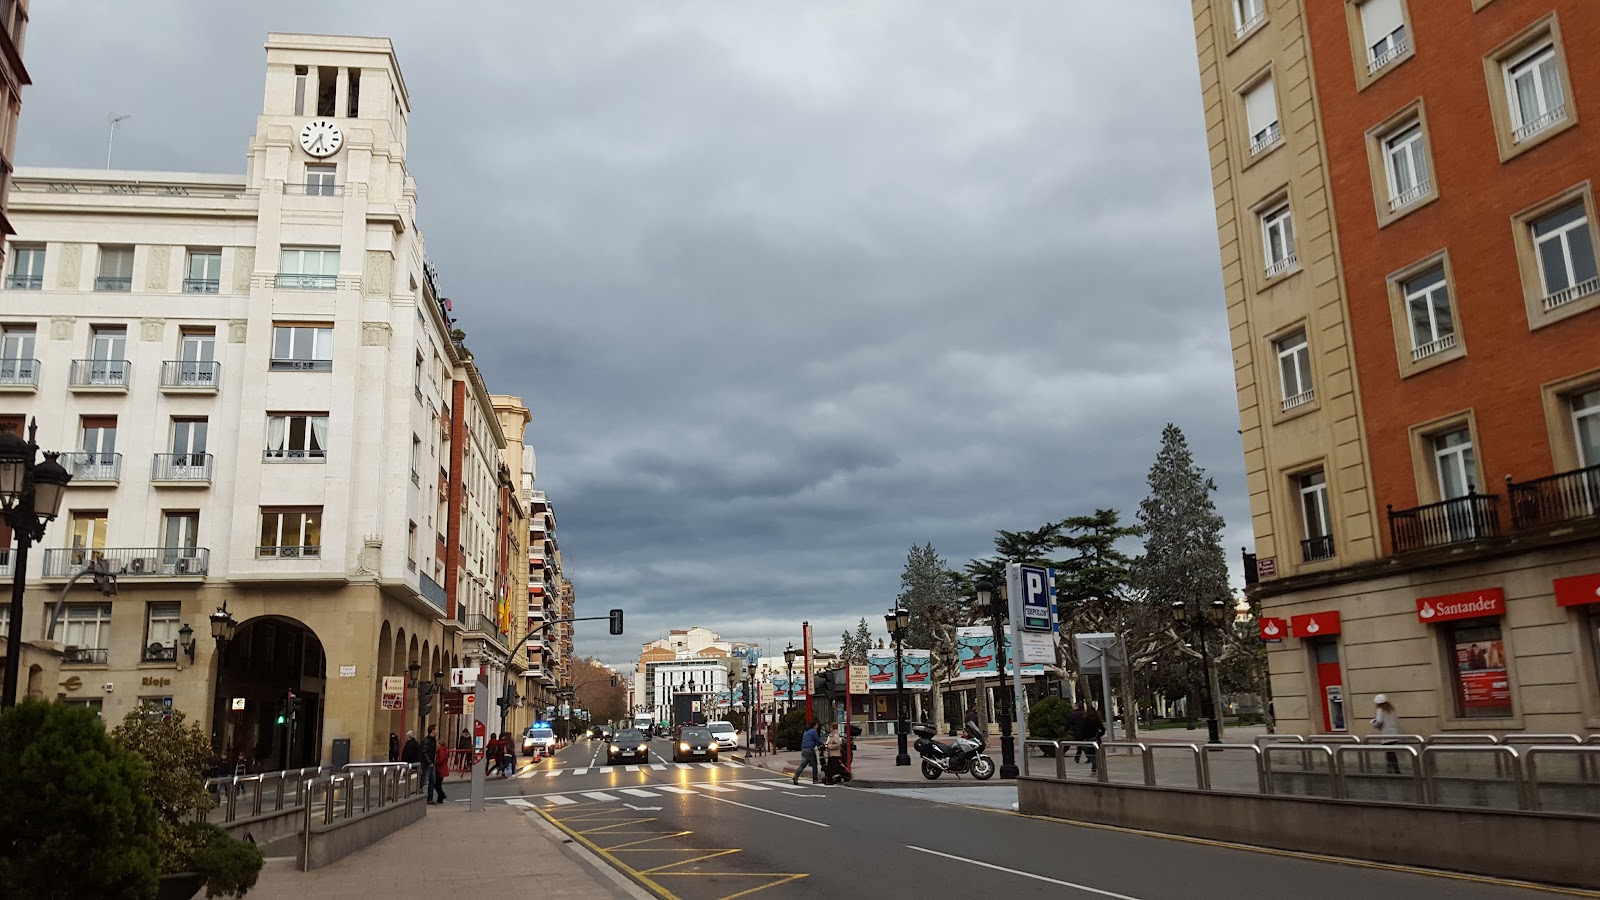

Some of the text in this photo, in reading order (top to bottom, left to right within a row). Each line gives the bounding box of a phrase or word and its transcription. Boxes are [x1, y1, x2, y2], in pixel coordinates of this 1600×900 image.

[1026, 572, 1042, 604] P
[1436, 596, 1497, 616] Santander
[142, 676, 170, 687] Rioja
